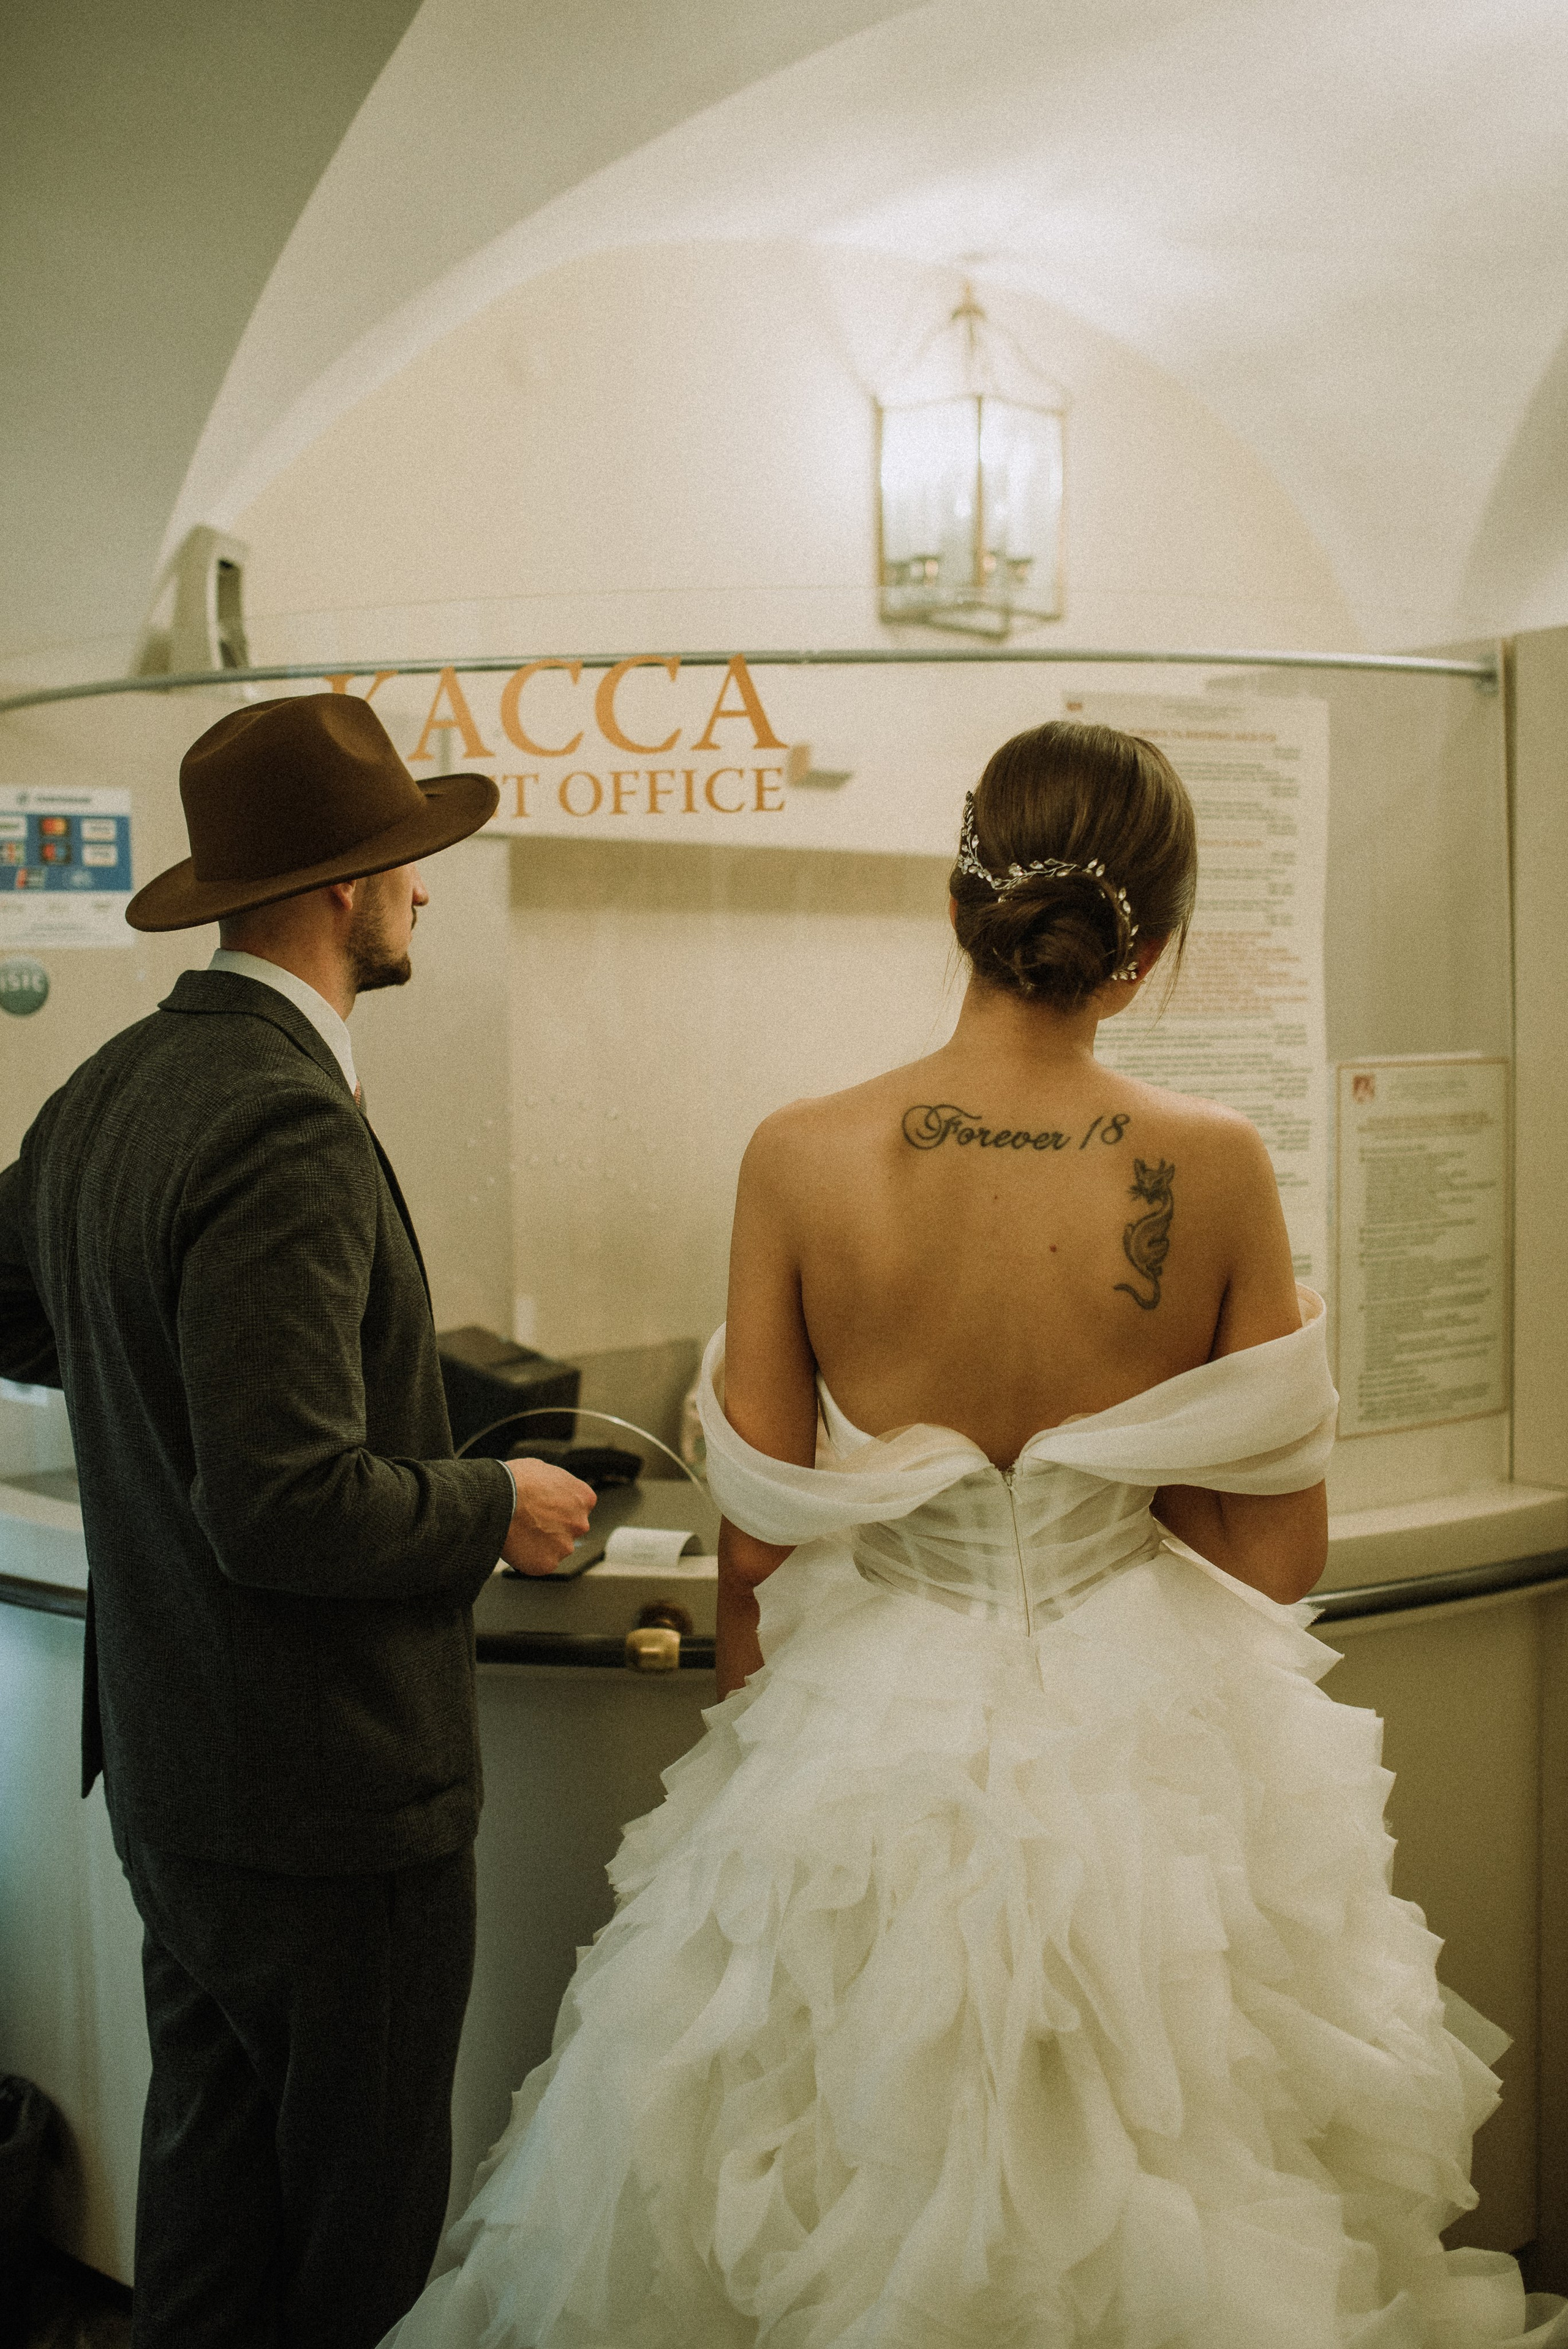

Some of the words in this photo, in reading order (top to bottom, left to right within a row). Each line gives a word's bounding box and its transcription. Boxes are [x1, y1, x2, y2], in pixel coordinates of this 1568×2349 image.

[557, 767, 786, 818] OFFICE
[902, 1104, 1071, 1151] Forever
[1079, 1113, 1131, 1150] 18
